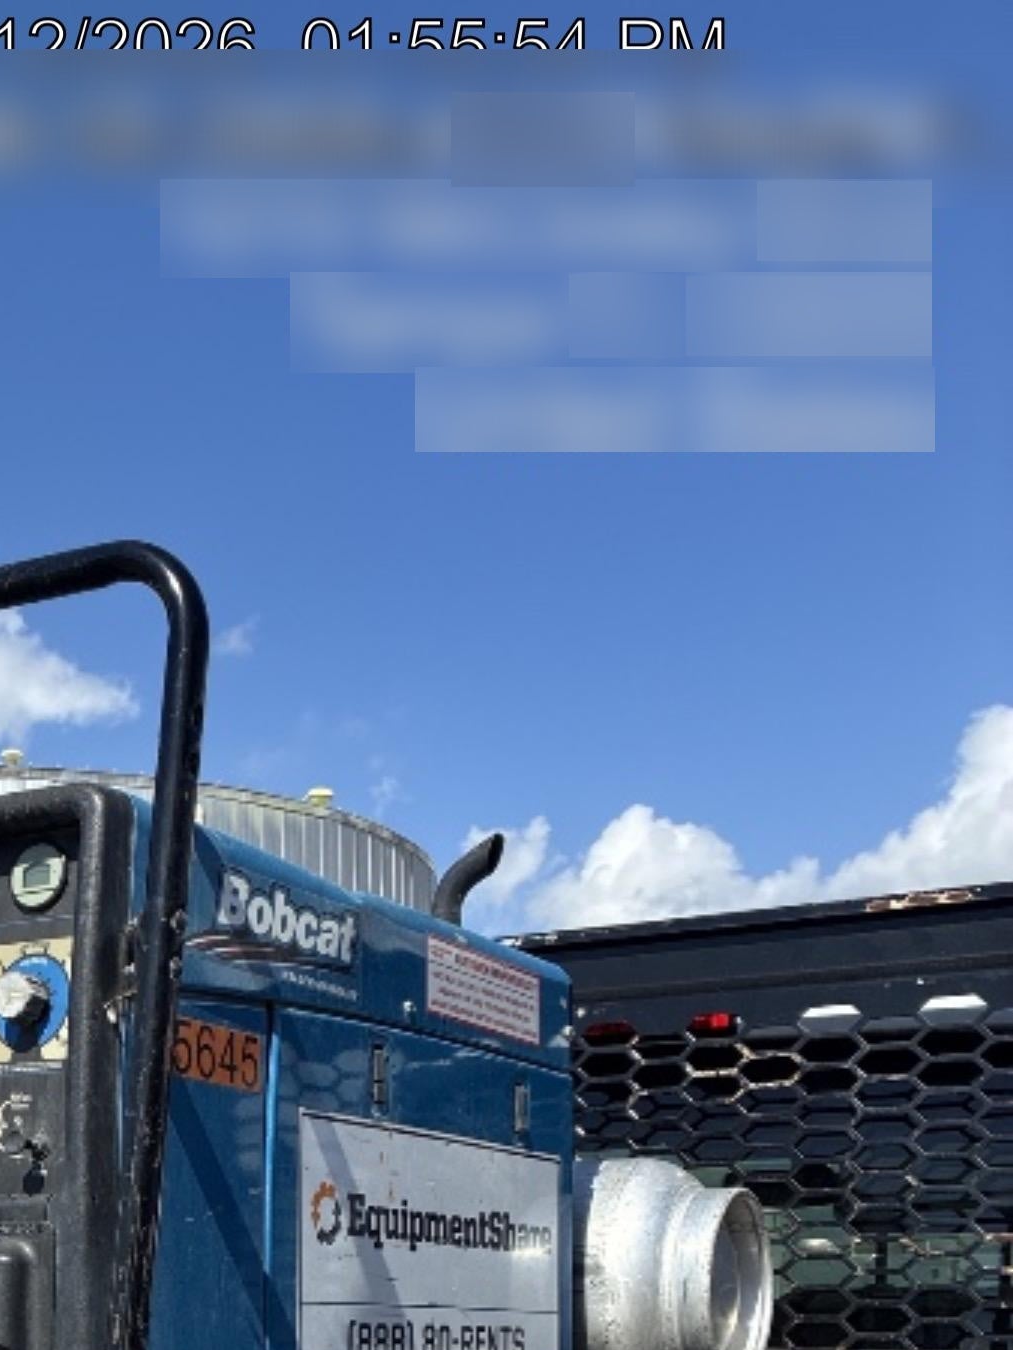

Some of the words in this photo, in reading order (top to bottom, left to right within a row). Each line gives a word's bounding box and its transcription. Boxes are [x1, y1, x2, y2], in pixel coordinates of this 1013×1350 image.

[217, 872, 357, 964] Bobcat
[172, 1020, 259, 1087] 5645
[346, 1192, 552, 1252] EquipmentShare
